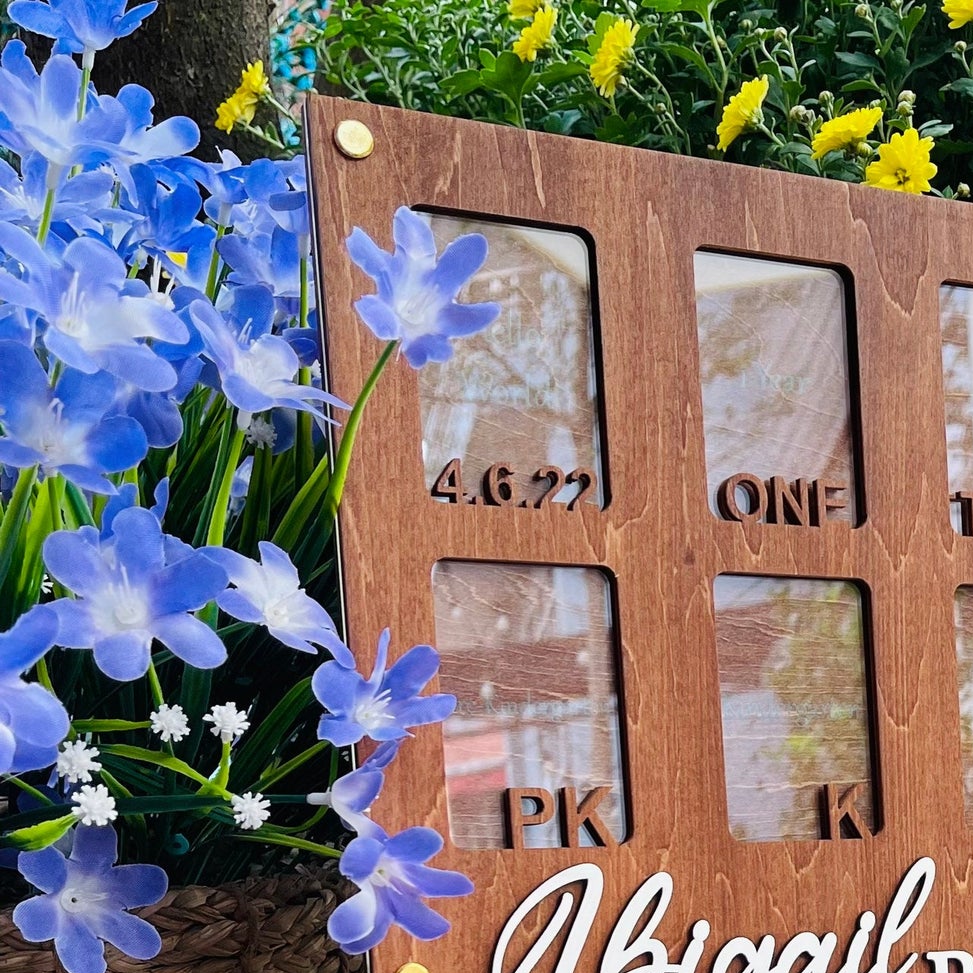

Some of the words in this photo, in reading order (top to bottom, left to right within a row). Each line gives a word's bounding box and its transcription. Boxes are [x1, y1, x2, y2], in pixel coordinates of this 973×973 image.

[717, 472, 848, 527] ONE
[504, 786, 620, 850] PK
[818, 782, 875, 841] K
